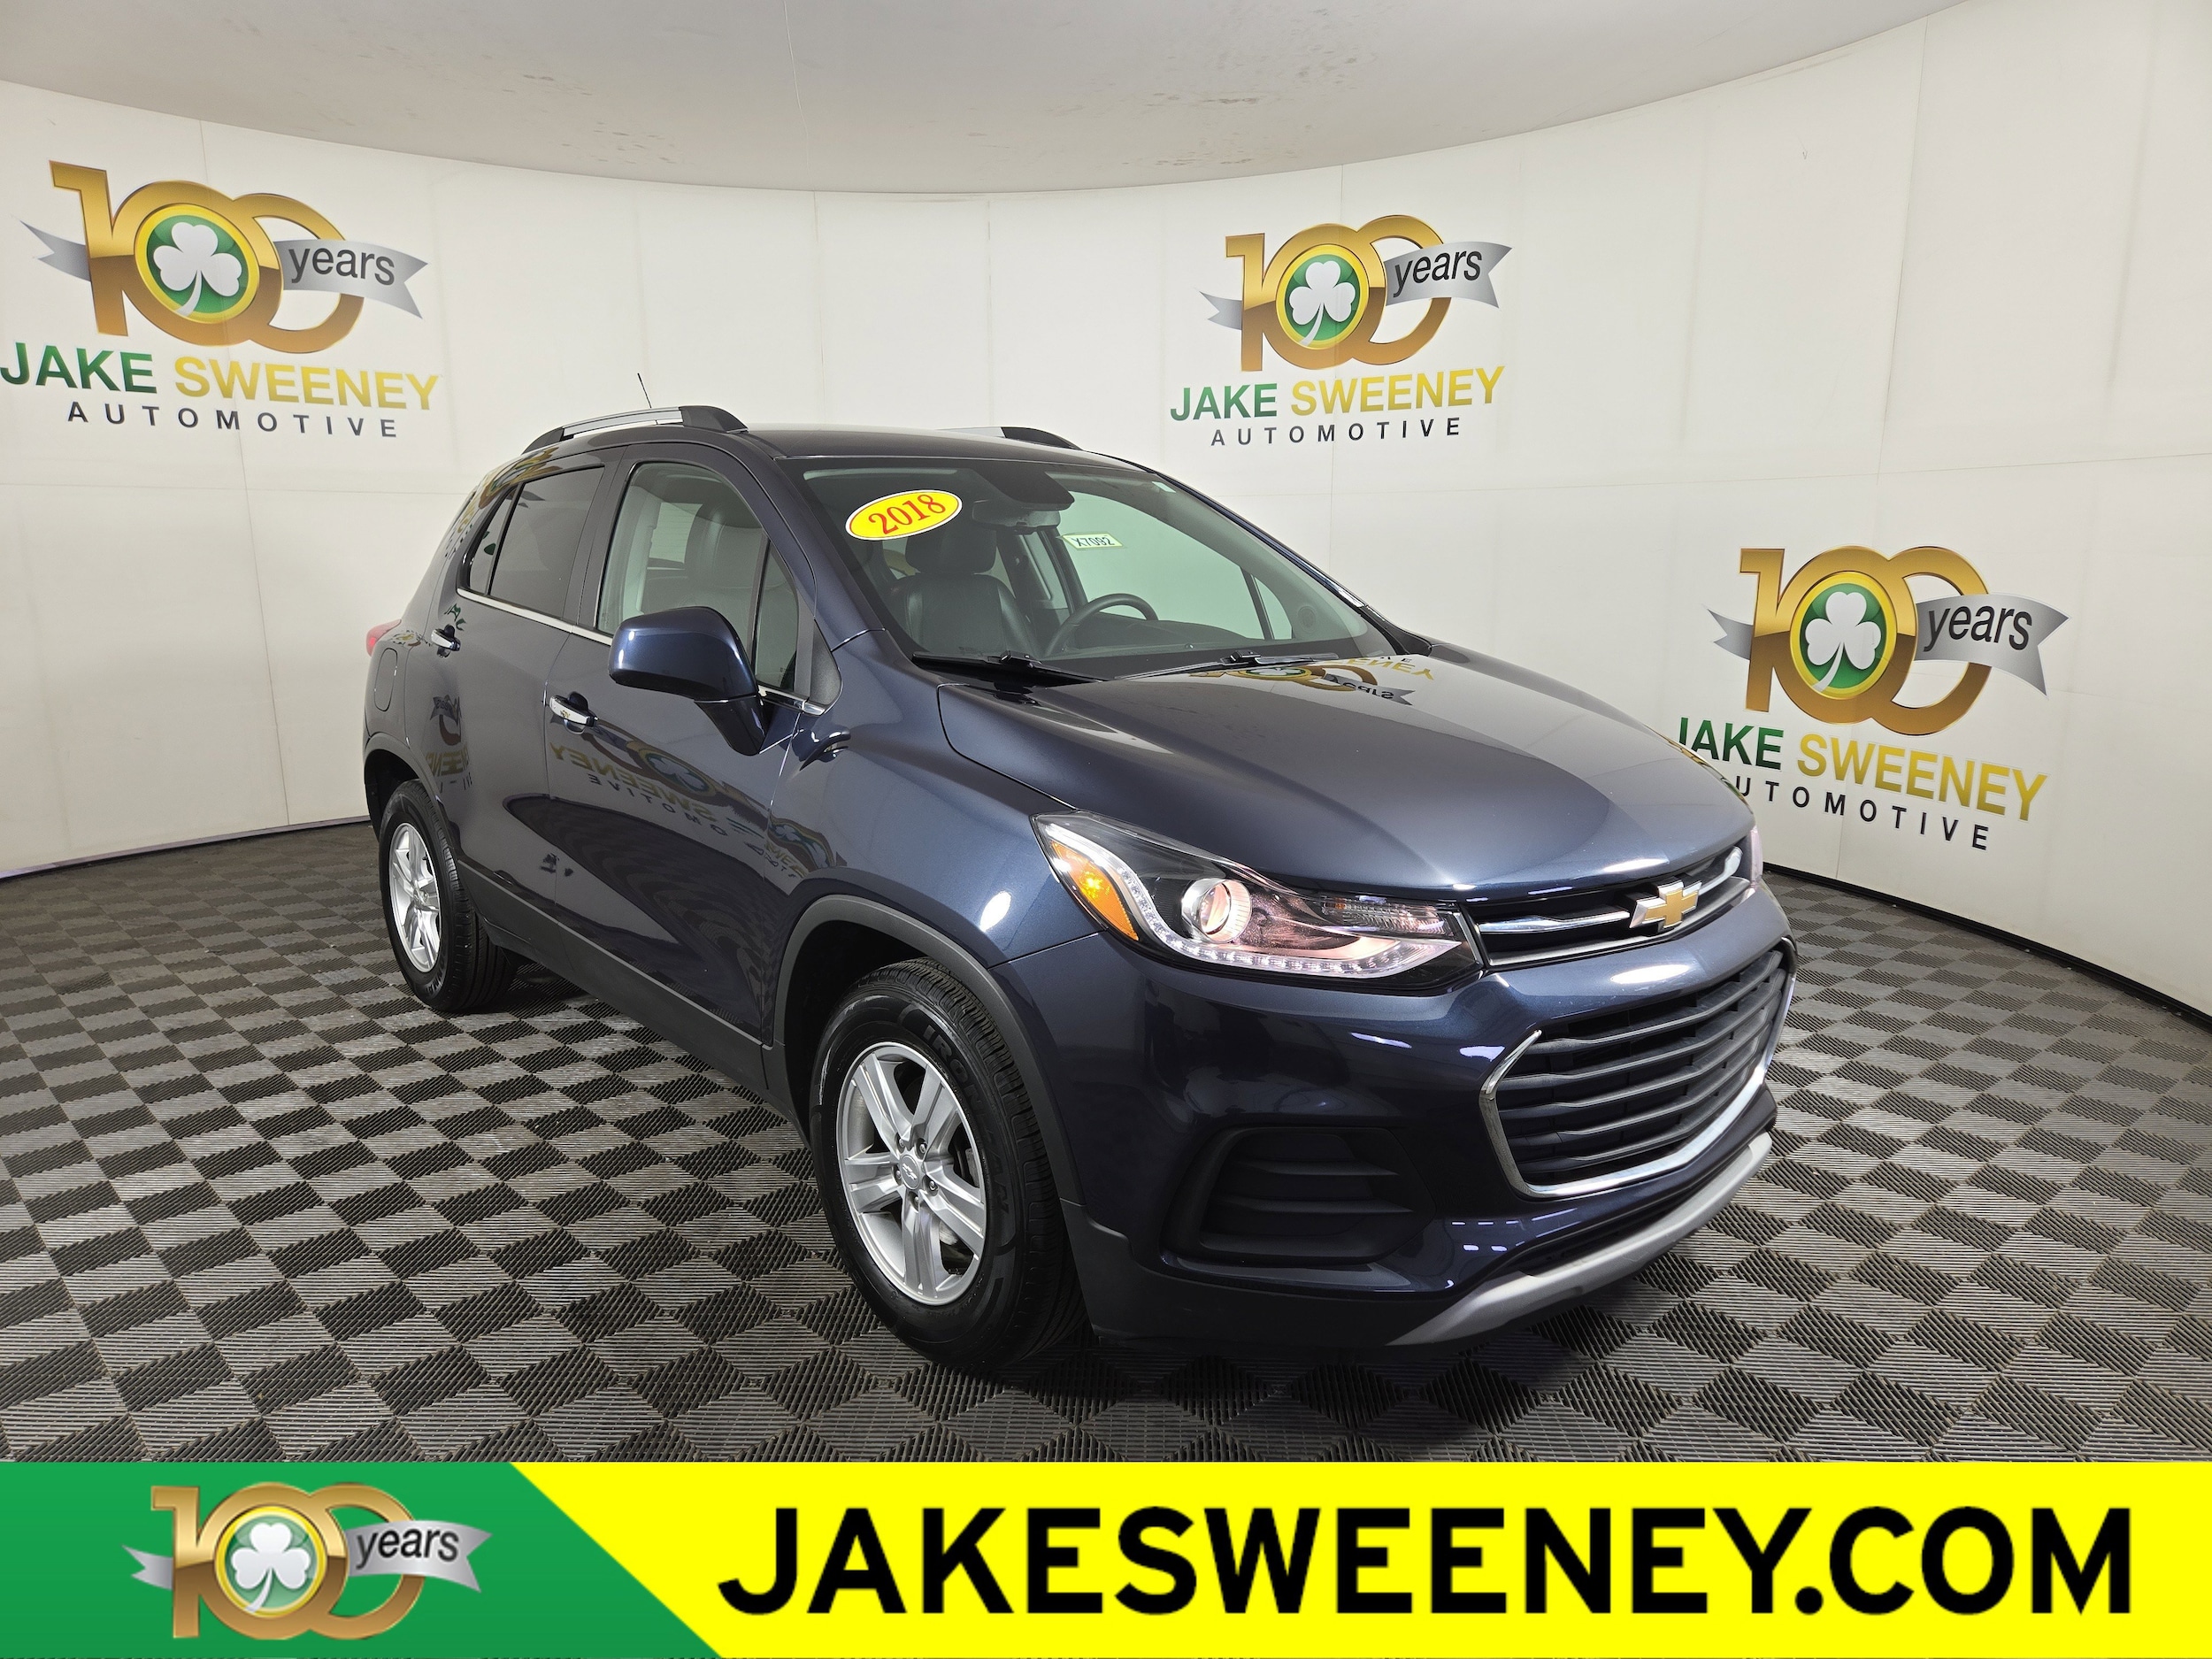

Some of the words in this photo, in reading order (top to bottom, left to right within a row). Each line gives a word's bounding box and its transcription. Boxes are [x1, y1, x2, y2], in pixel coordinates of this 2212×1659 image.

[288, 247, 396, 286] years
[1393, 250, 1483, 298] years
[0, 342, 157, 394] JAKE
[174, 357, 439, 410] SWEENEY
[1170, 383, 1278, 421] JAKE
[1291, 365, 1506, 416] SWEENEY
[67, 402, 396, 438] AUTOMOTIVE
[1210, 417, 1460, 446] AUTOMOTIVE
[868, 494, 946, 534] 2018
[1071, 535, 1115, 547] X7092
[1924, 605, 2032, 652] years
[1797, 733, 2048, 821] SWEENEY
[1735, 775, 1989, 850] UTOMOTIVE
